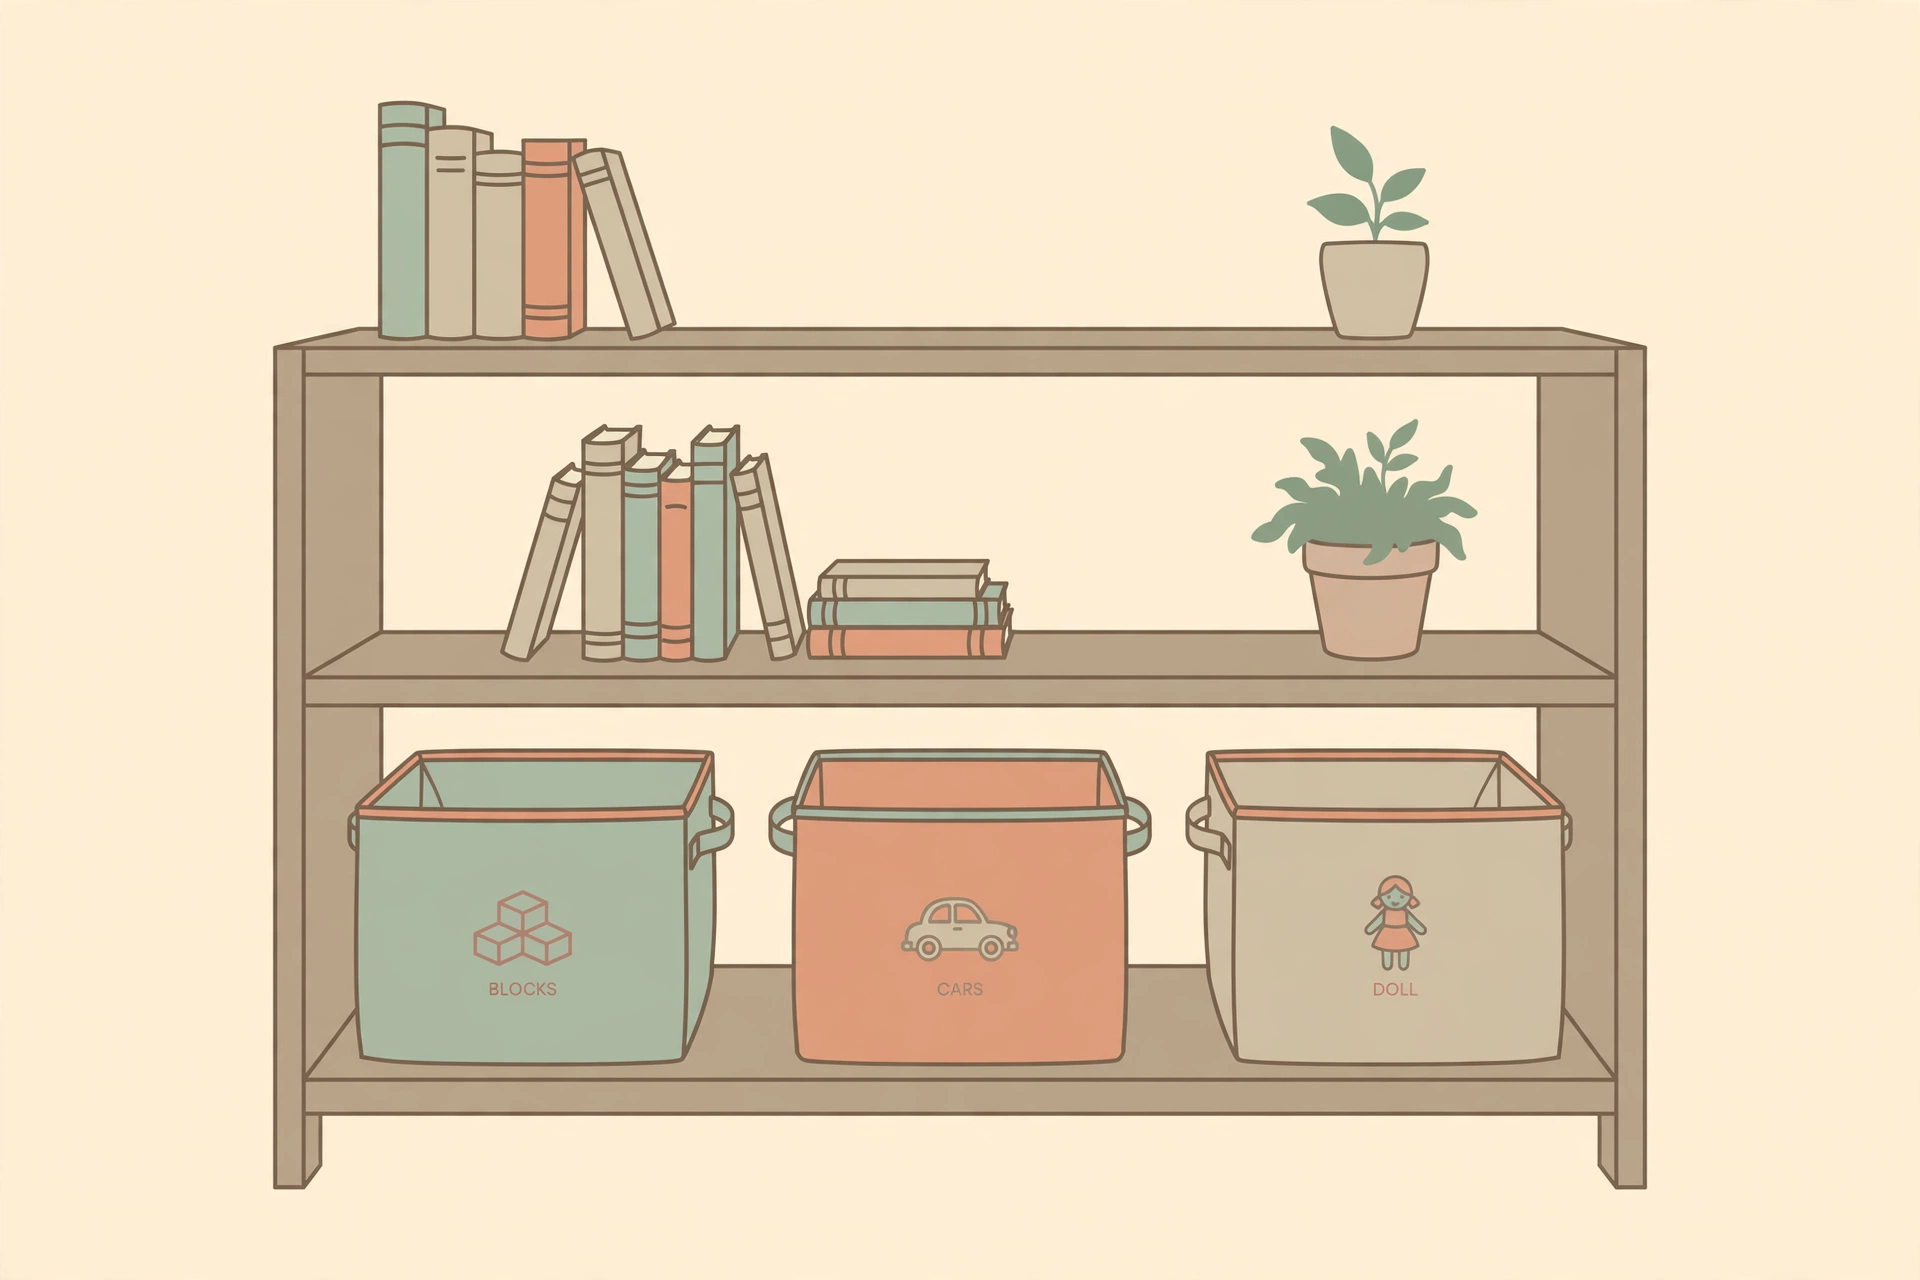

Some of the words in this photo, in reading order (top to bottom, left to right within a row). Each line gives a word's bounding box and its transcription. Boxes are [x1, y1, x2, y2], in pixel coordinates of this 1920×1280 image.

[489, 981, 557, 996] BLOCKS
[937, 981, 983, 996] CARS
[1373, 982, 1419, 996] DOLL
